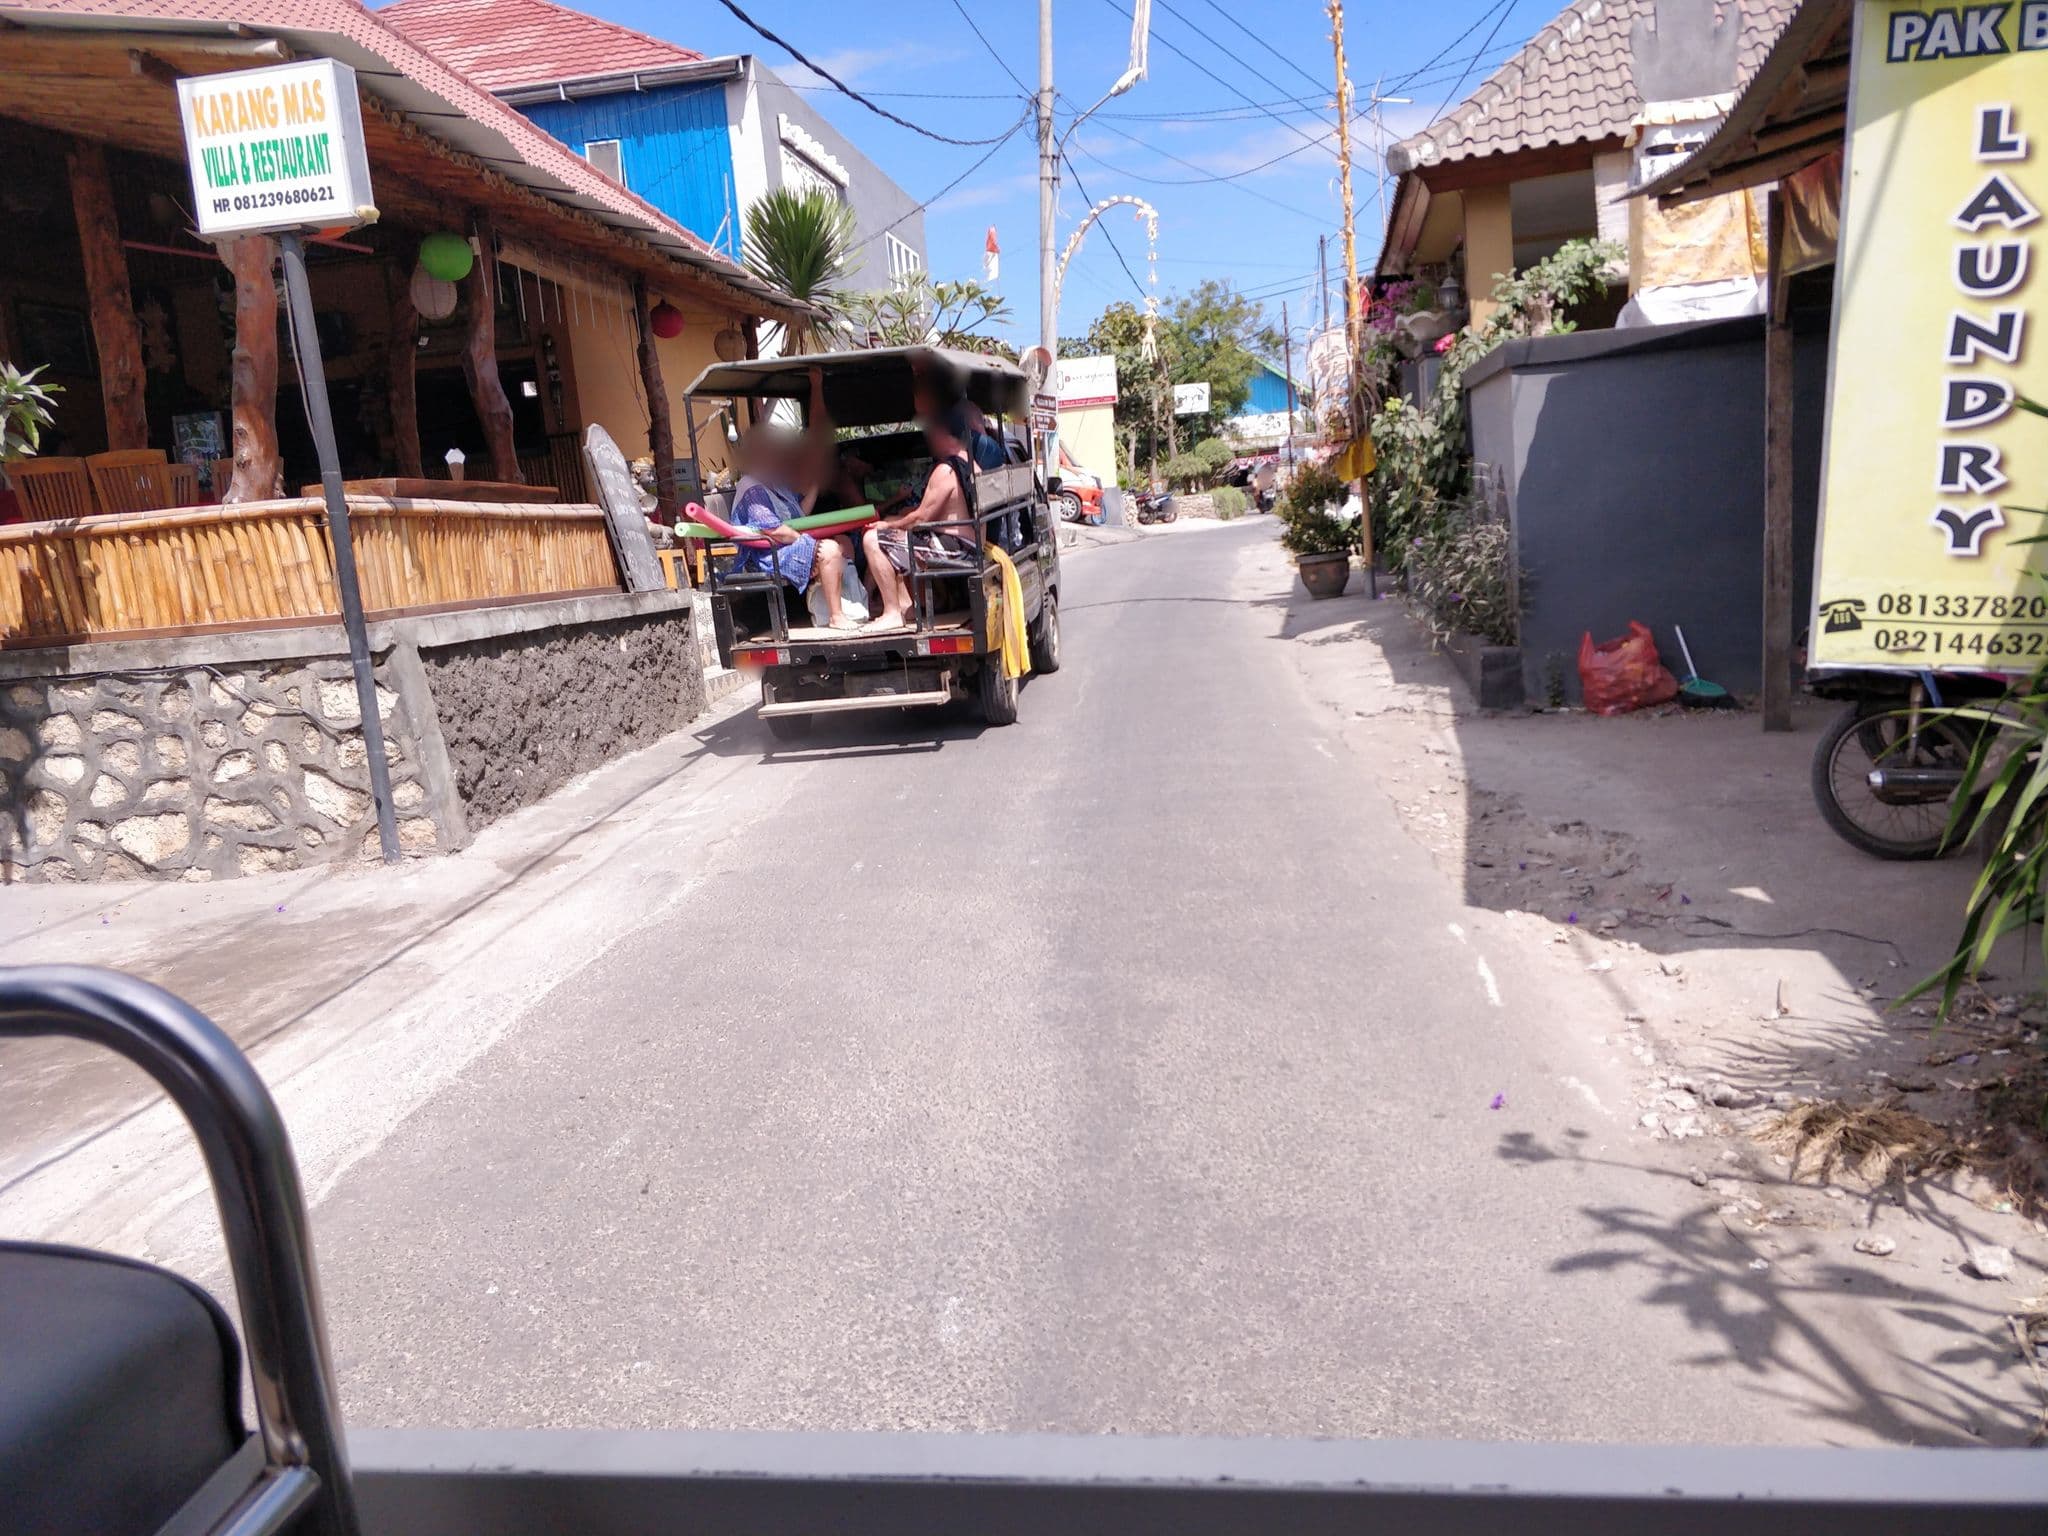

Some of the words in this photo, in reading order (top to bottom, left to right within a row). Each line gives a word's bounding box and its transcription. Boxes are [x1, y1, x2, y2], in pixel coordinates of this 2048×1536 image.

[1887, 3, 2013, 63] PAK
[192, 88, 278, 137] KARANG
[283, 80, 326, 123] MAS
[201, 145, 239, 188] VILLA
[240, 143, 250, 185] &
[251, 133, 332, 182] RESTAURANT
[234, 186, 335, 211] 081239680621
[1930, 104, 2041, 556] LAUNDRY
[1875, 629, 2048, 656] 082144632
